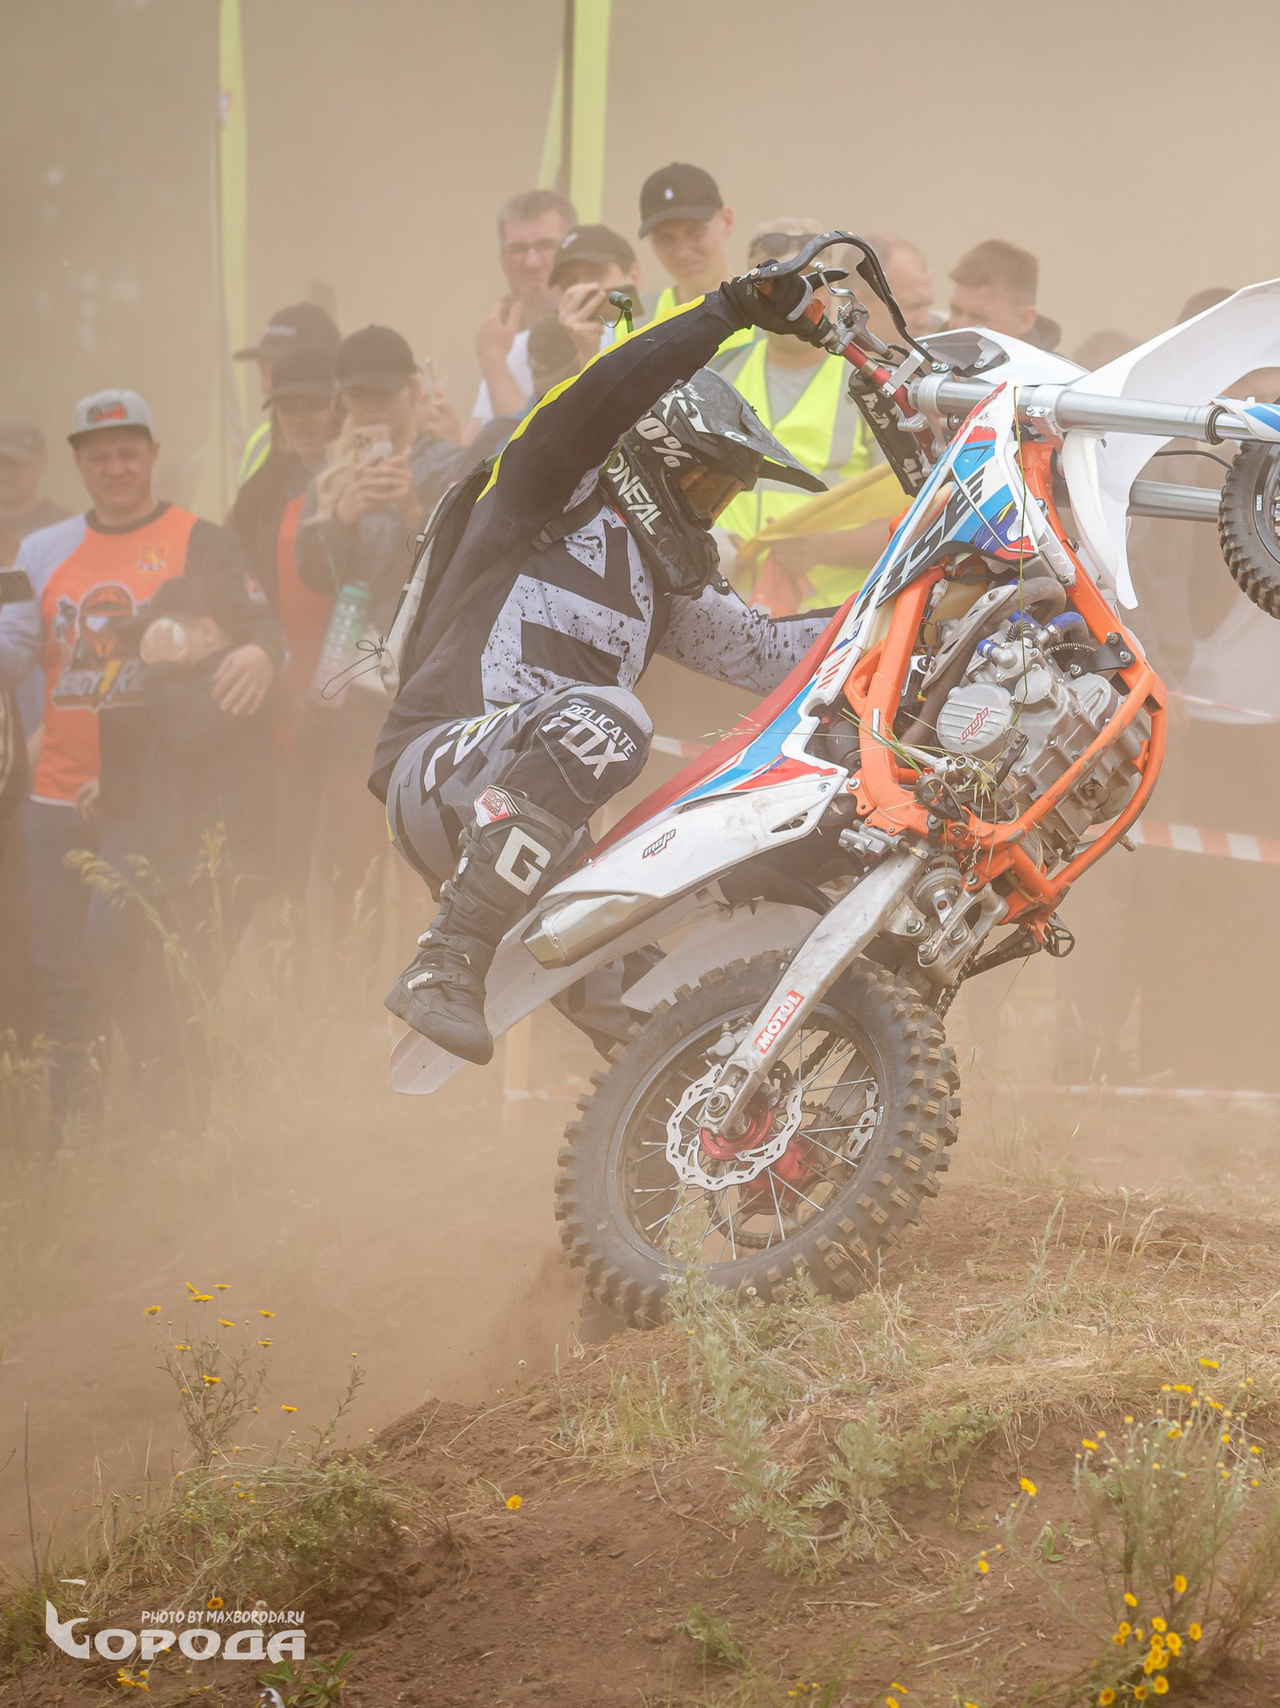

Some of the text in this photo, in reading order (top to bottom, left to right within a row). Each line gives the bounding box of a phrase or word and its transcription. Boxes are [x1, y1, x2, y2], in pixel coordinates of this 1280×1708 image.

[541, 710, 629, 780] FOX
[563, 703, 638, 757] DELICATE
[756, 994, 802, 1051] MOTUL
